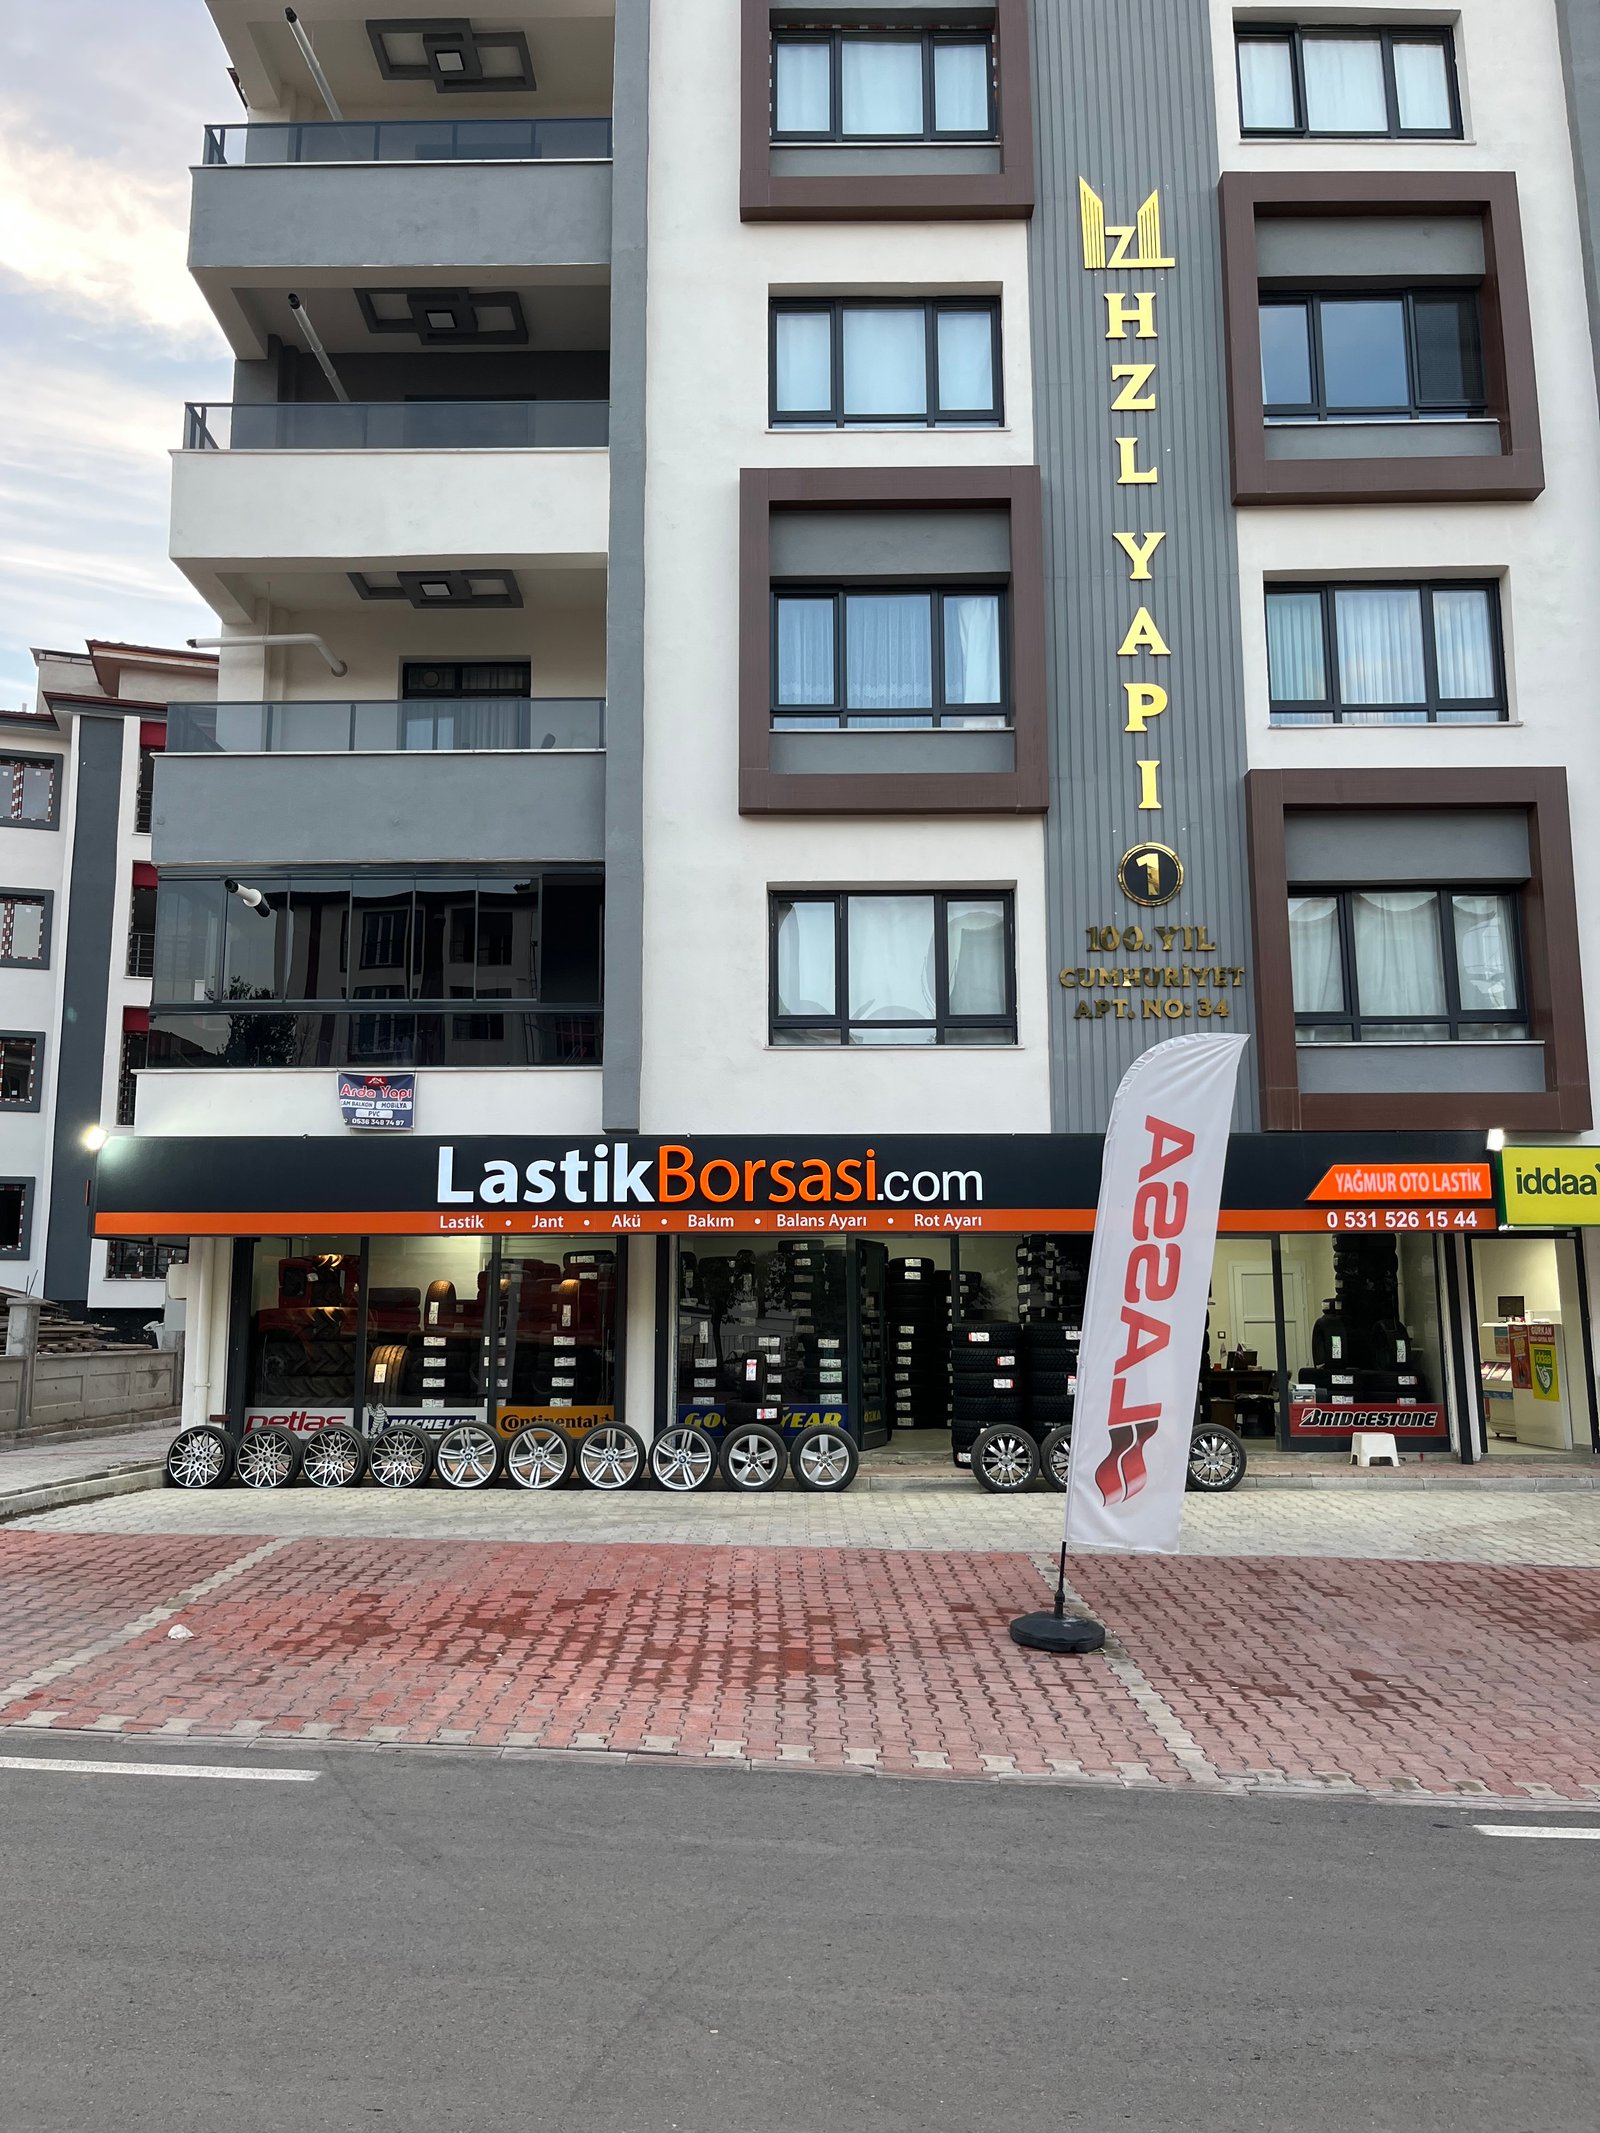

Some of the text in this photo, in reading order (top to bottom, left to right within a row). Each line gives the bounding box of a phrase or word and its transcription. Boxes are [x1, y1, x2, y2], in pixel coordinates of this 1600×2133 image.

[1103, 292, 1172, 809] HZL YAPI
[1136, 853, 1160, 896] 1
[1086, 925, 1216, 952] 100. YIL
[1059, 962, 1246, 988] CUMHURİYET
[1074, 998, 1230, 1019] APT. NO: 34
[1334, 1168, 1482, 1193] YAĞMUR OTO LASTİK
[1515, 1166, 1598, 1195] iddaa
[439, 1213, 982, 1230] Lastik Jant Akü Bakım Balans Ayarı Rot Ayarı
[1327, 1211, 1478, 1228] 0 531 526 15 44
